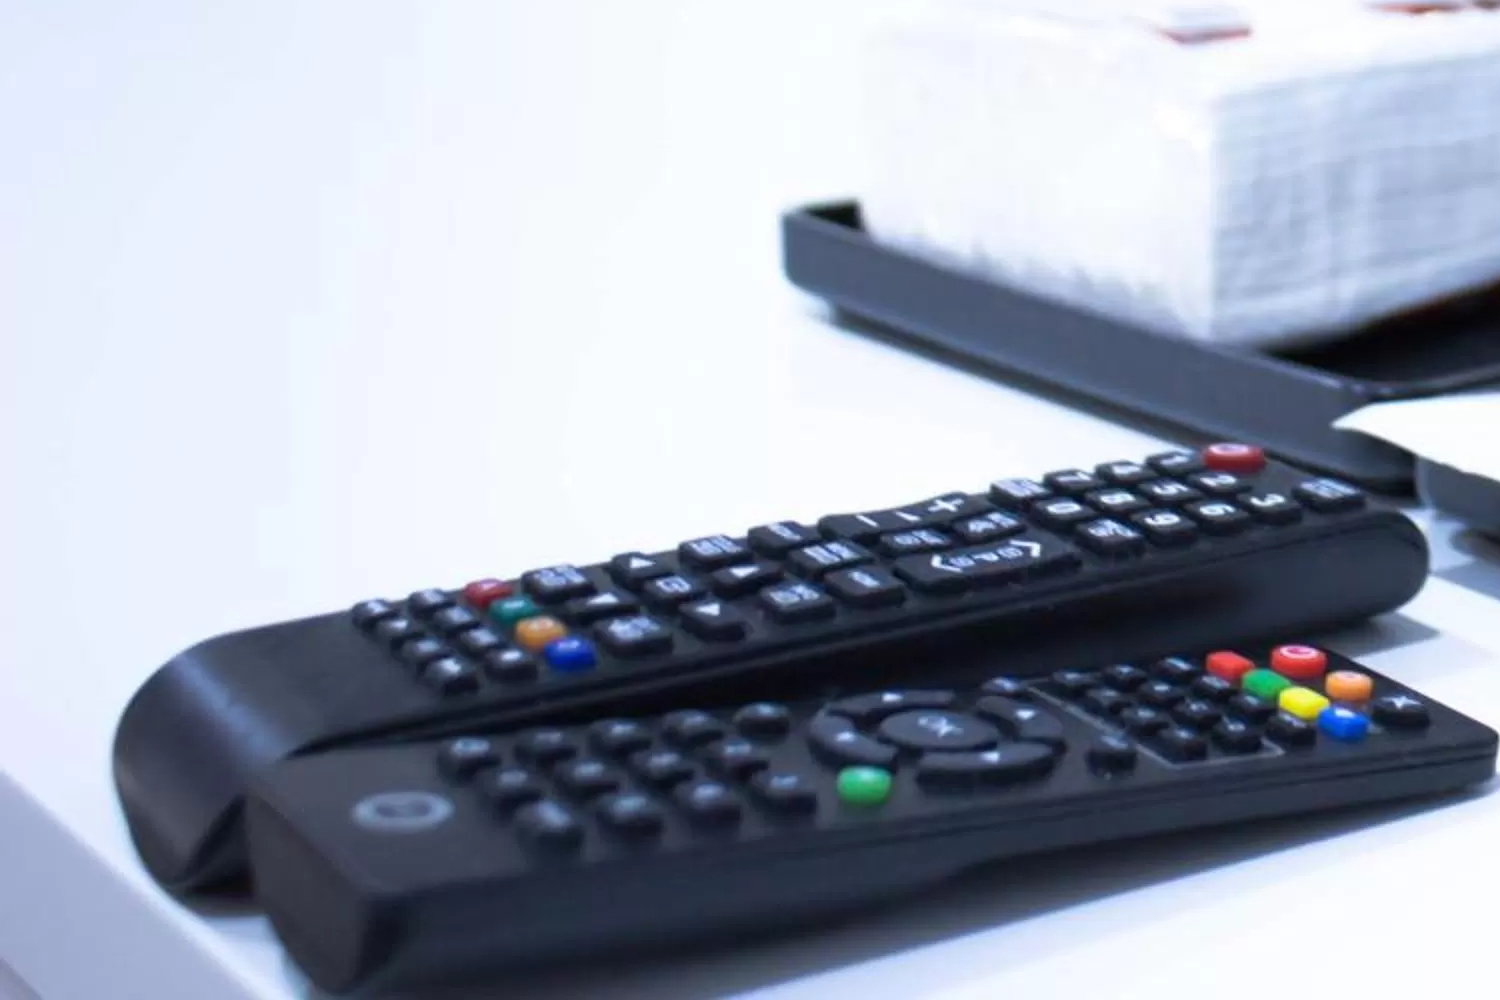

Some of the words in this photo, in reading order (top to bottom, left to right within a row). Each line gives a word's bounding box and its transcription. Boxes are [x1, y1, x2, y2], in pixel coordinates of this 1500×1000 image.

[1200, 473, 1237, 487] 2
[1151, 482, 1189, 496] 5
[1100, 491, 1137, 505] 8
[1250, 493, 1286, 508] 3
[1046, 501, 1082, 515] 0
[1199, 503, 1236, 517] 6
[1143, 512, 1181, 527] 9
